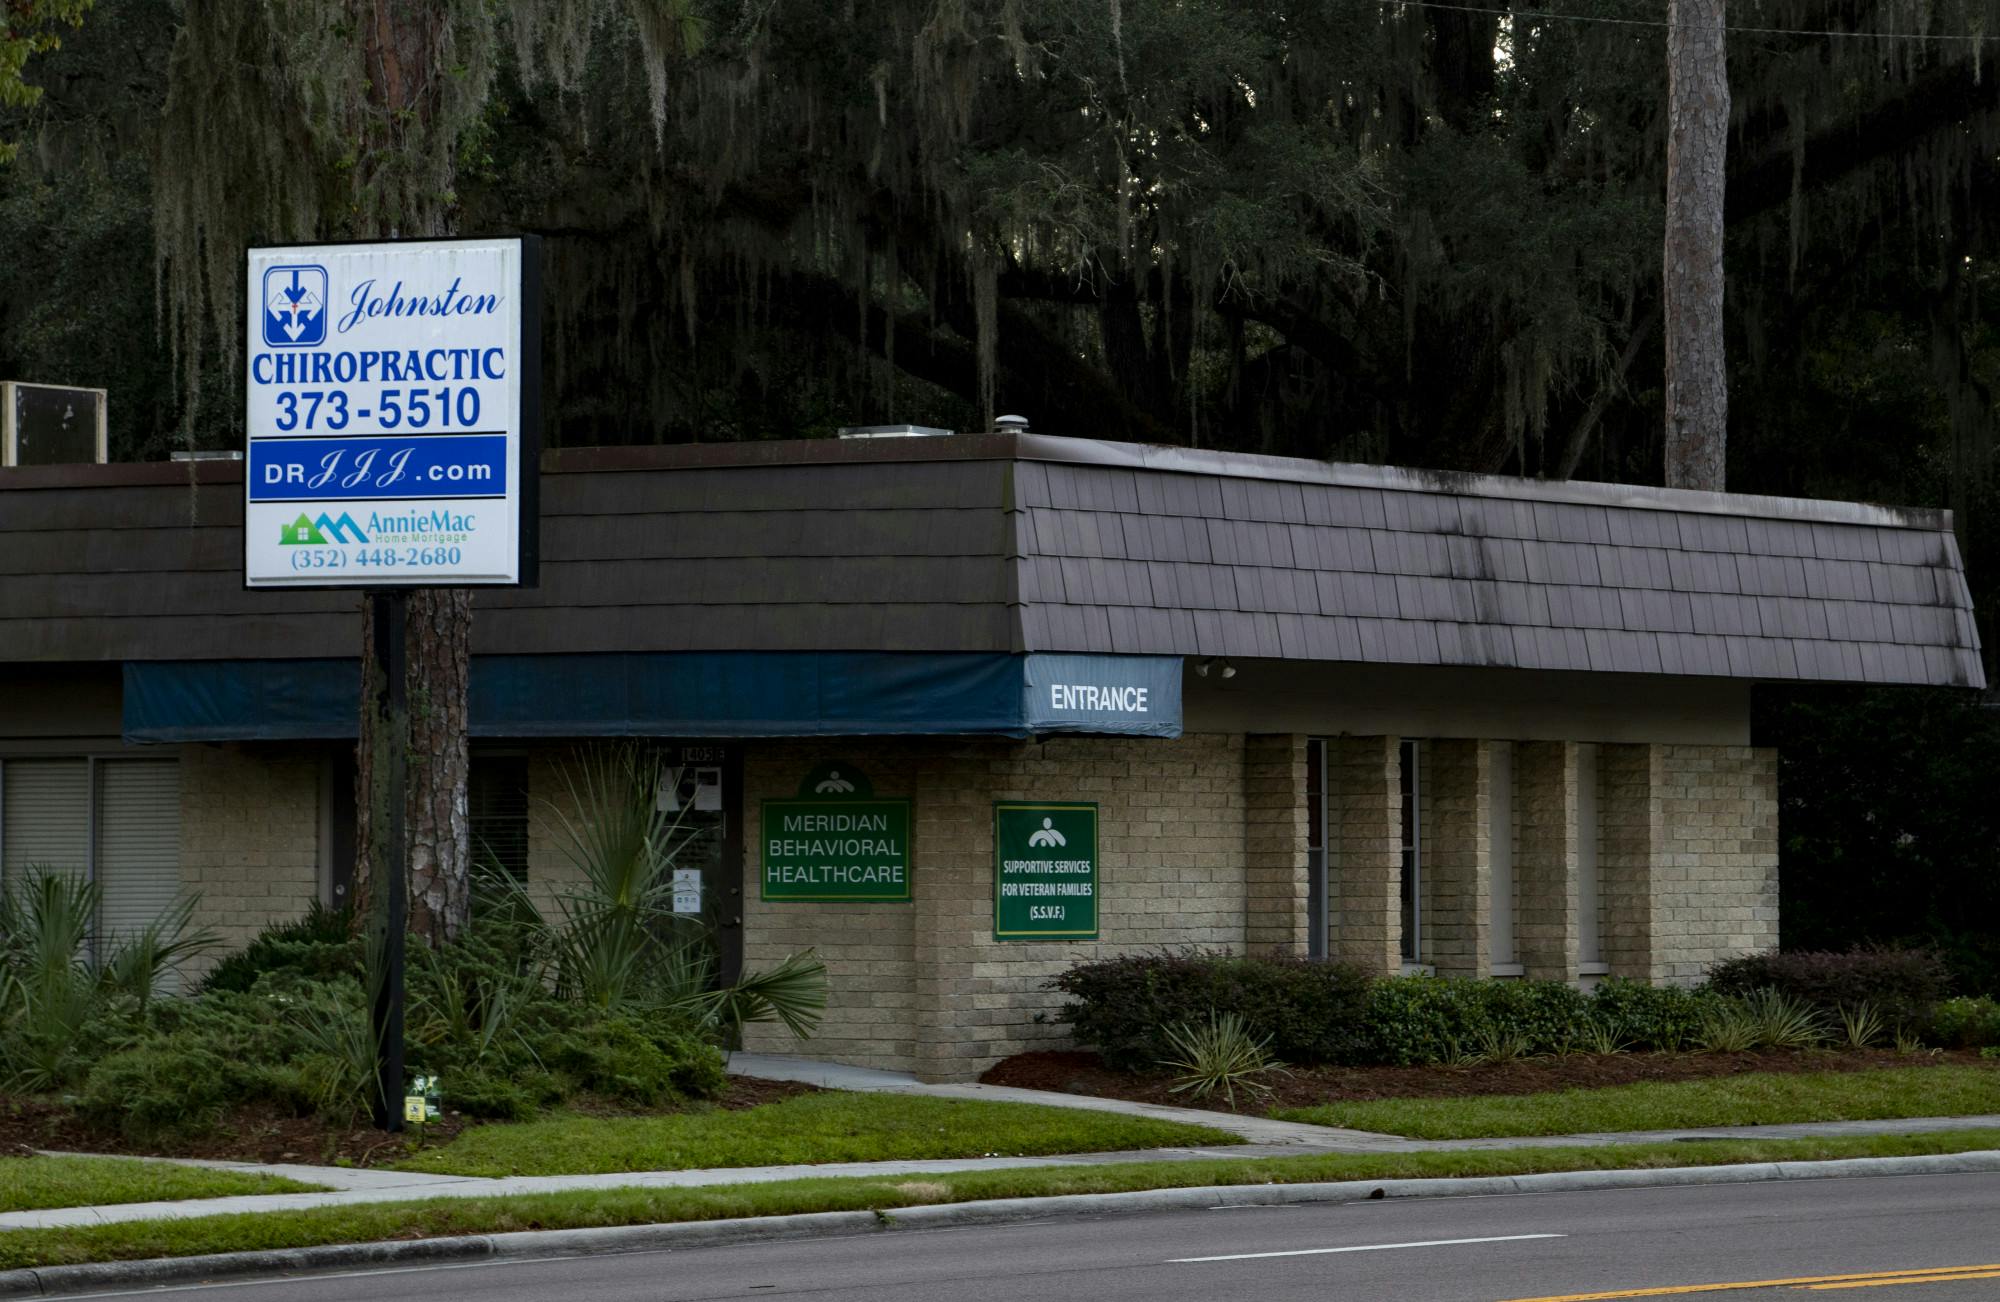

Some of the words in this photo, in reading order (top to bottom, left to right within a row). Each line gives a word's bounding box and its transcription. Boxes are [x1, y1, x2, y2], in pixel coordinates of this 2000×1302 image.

[337, 277, 505, 334] Johnston
[252, 347, 506, 385] CHIROPRACTIC
[275, 386, 481, 432] 373-5510
[366, 509, 476, 534] AnnieMac
[375, 534, 407, 543] Home
[411, 532, 468, 544] Mortgage
[291, 549, 347, 570] (352)
[355, 547, 462, 567] 448-2680
[1051, 684, 1149, 712] ENTRANCE
[783, 815, 888, 832] MERIDIAN
[769, 839, 902, 856] BEHAVIORAL
[767, 866, 904, 882] HEALTHCARE
[1003, 860, 1053, 874] SUPPORTIVE
[1054, 860, 1091, 873] SERVICES
[1002, 883, 1018, 896] FOR
[1018, 883, 1056, 896] VETERAN
[1057, 882, 1092, 896] FAMILIES
[1029, 905, 1065, 920] (S.S.V.F.)
